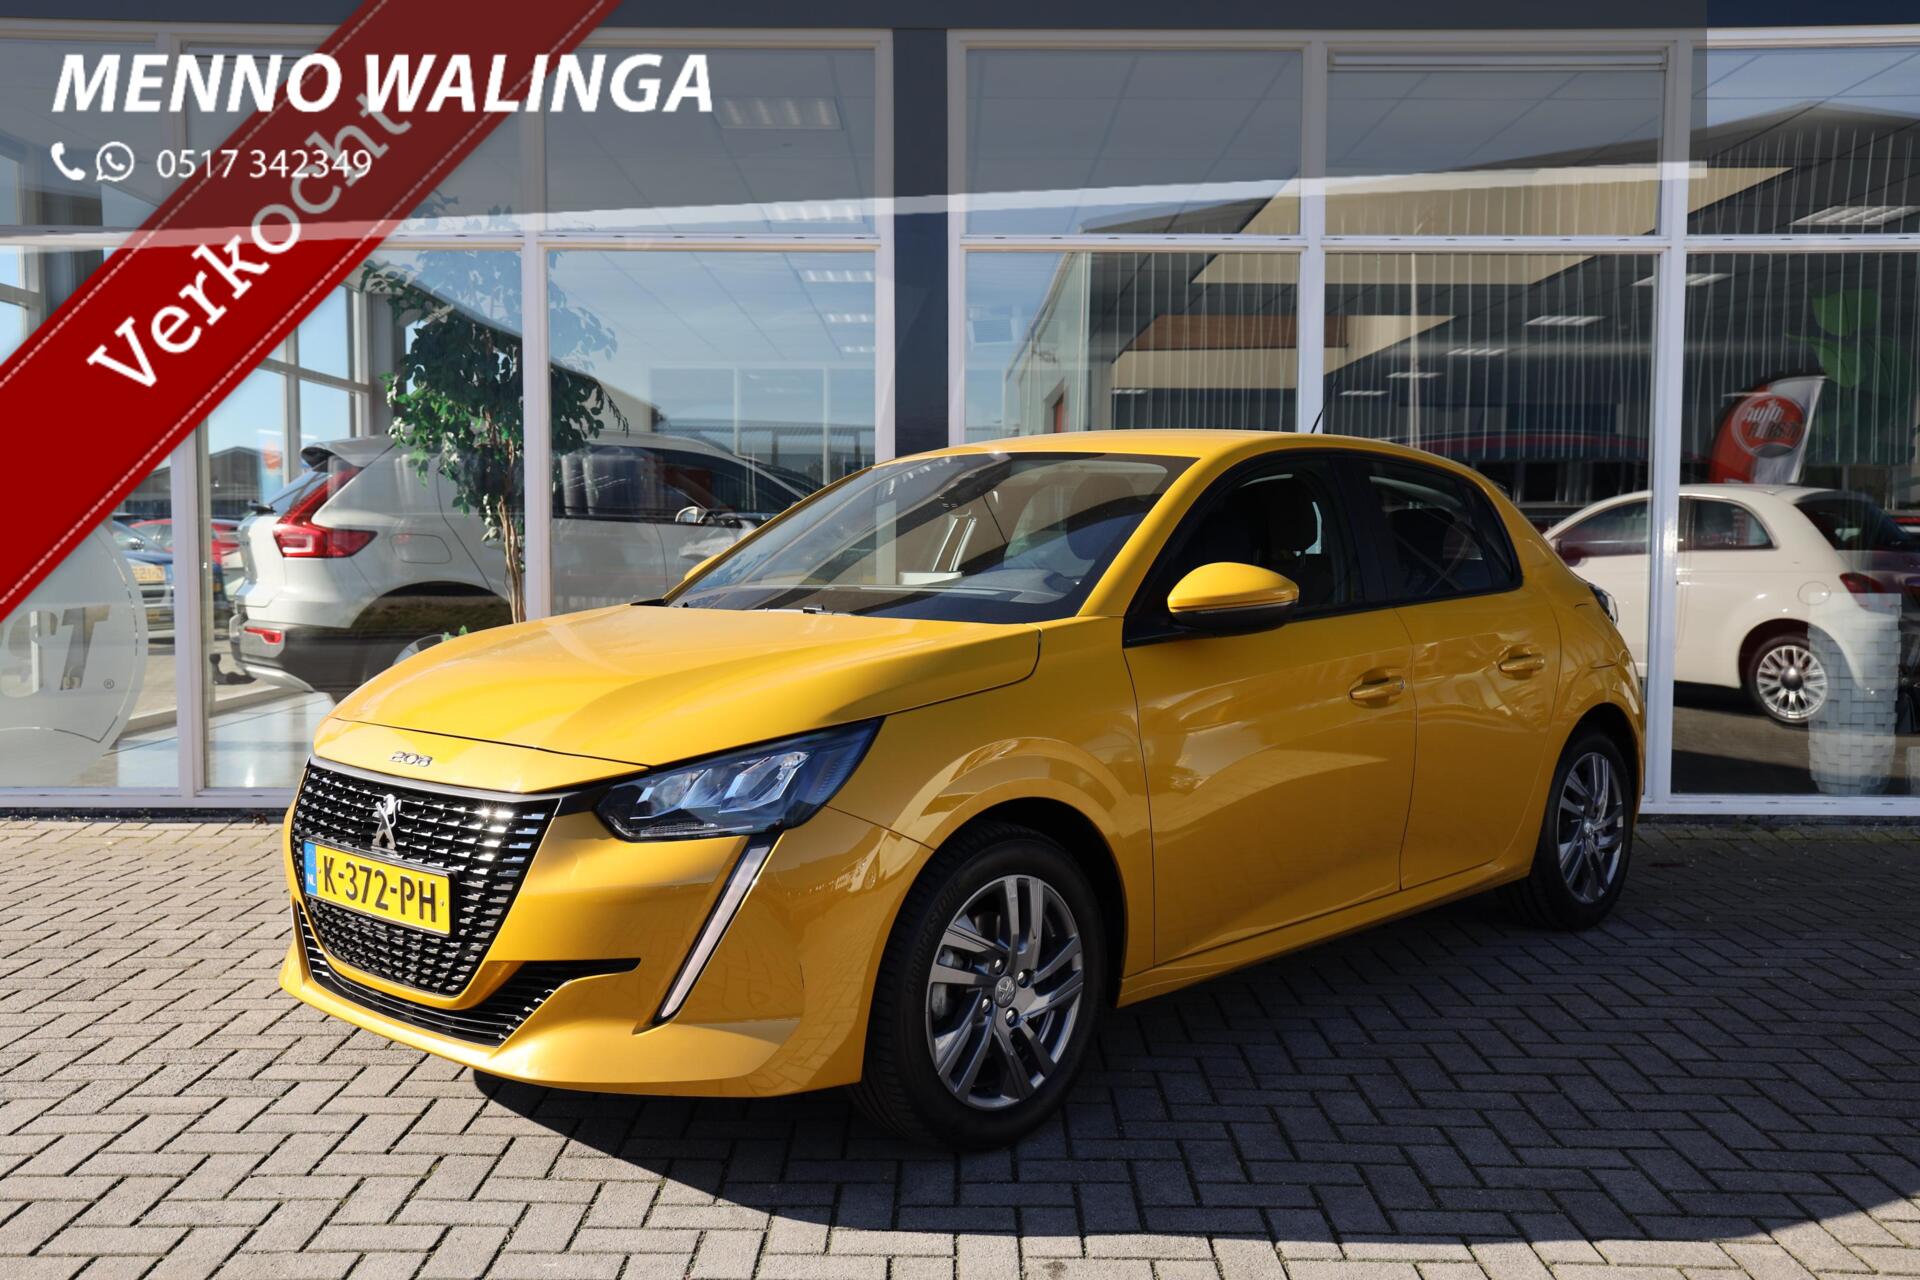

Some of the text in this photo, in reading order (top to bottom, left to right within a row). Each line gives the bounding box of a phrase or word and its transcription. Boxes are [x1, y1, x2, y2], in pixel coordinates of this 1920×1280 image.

[0, 605, 111, 698] ST
[389, 750, 433, 768] 208
[322, 854, 437, 923] K-372-PH
